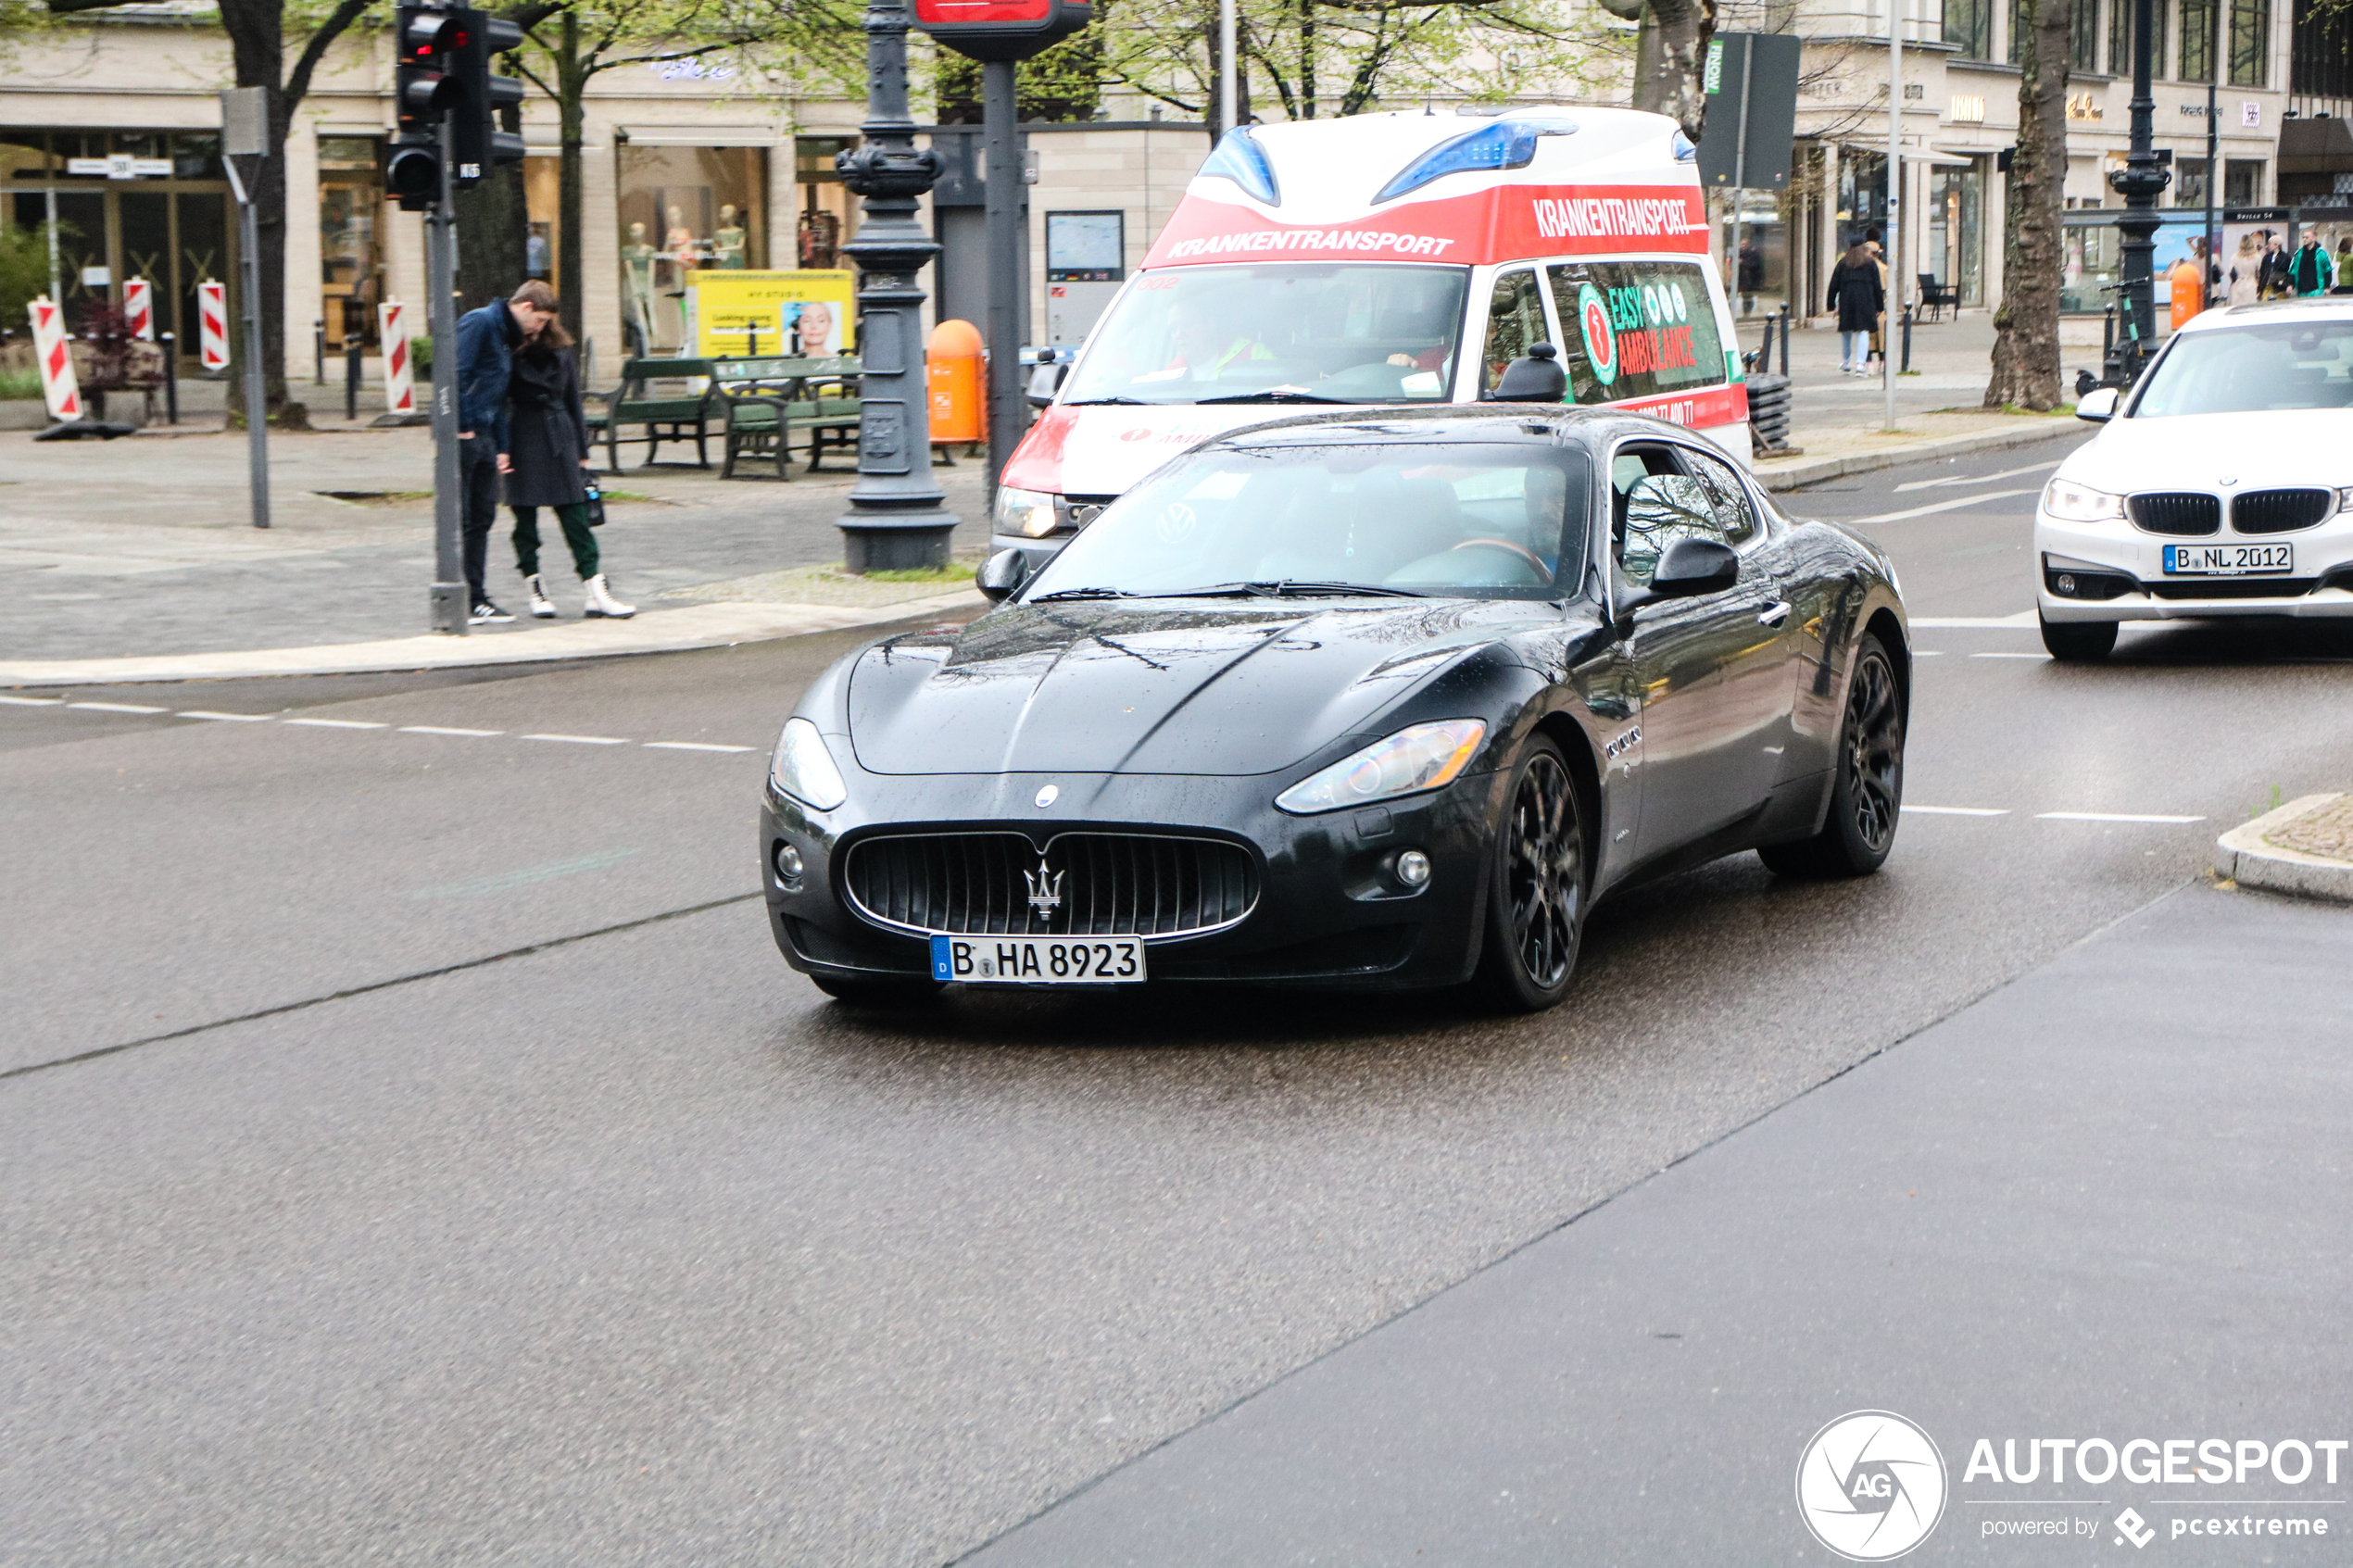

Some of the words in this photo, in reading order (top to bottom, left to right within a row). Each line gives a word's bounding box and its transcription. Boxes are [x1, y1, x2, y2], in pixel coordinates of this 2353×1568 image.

[1532, 199, 1691, 238] KRANKENTRANSPORT
[1165, 230, 1454, 259] KRANKENTRANSPORT
[1137, 276, 1180, 292] 002
[1607, 285, 1644, 331] EASY
[1617, 325, 1696, 377] AMBULANCE
[2177, 549, 2190, 568] B
[2205, 549, 2232, 568] NL
[2236, 546, 2288, 568] 2012
[938, 962, 947, 972] D
[952, 942, 975, 975] B
[997, 943, 1042, 976] HA
[1049, 943, 1137, 977] 8923
